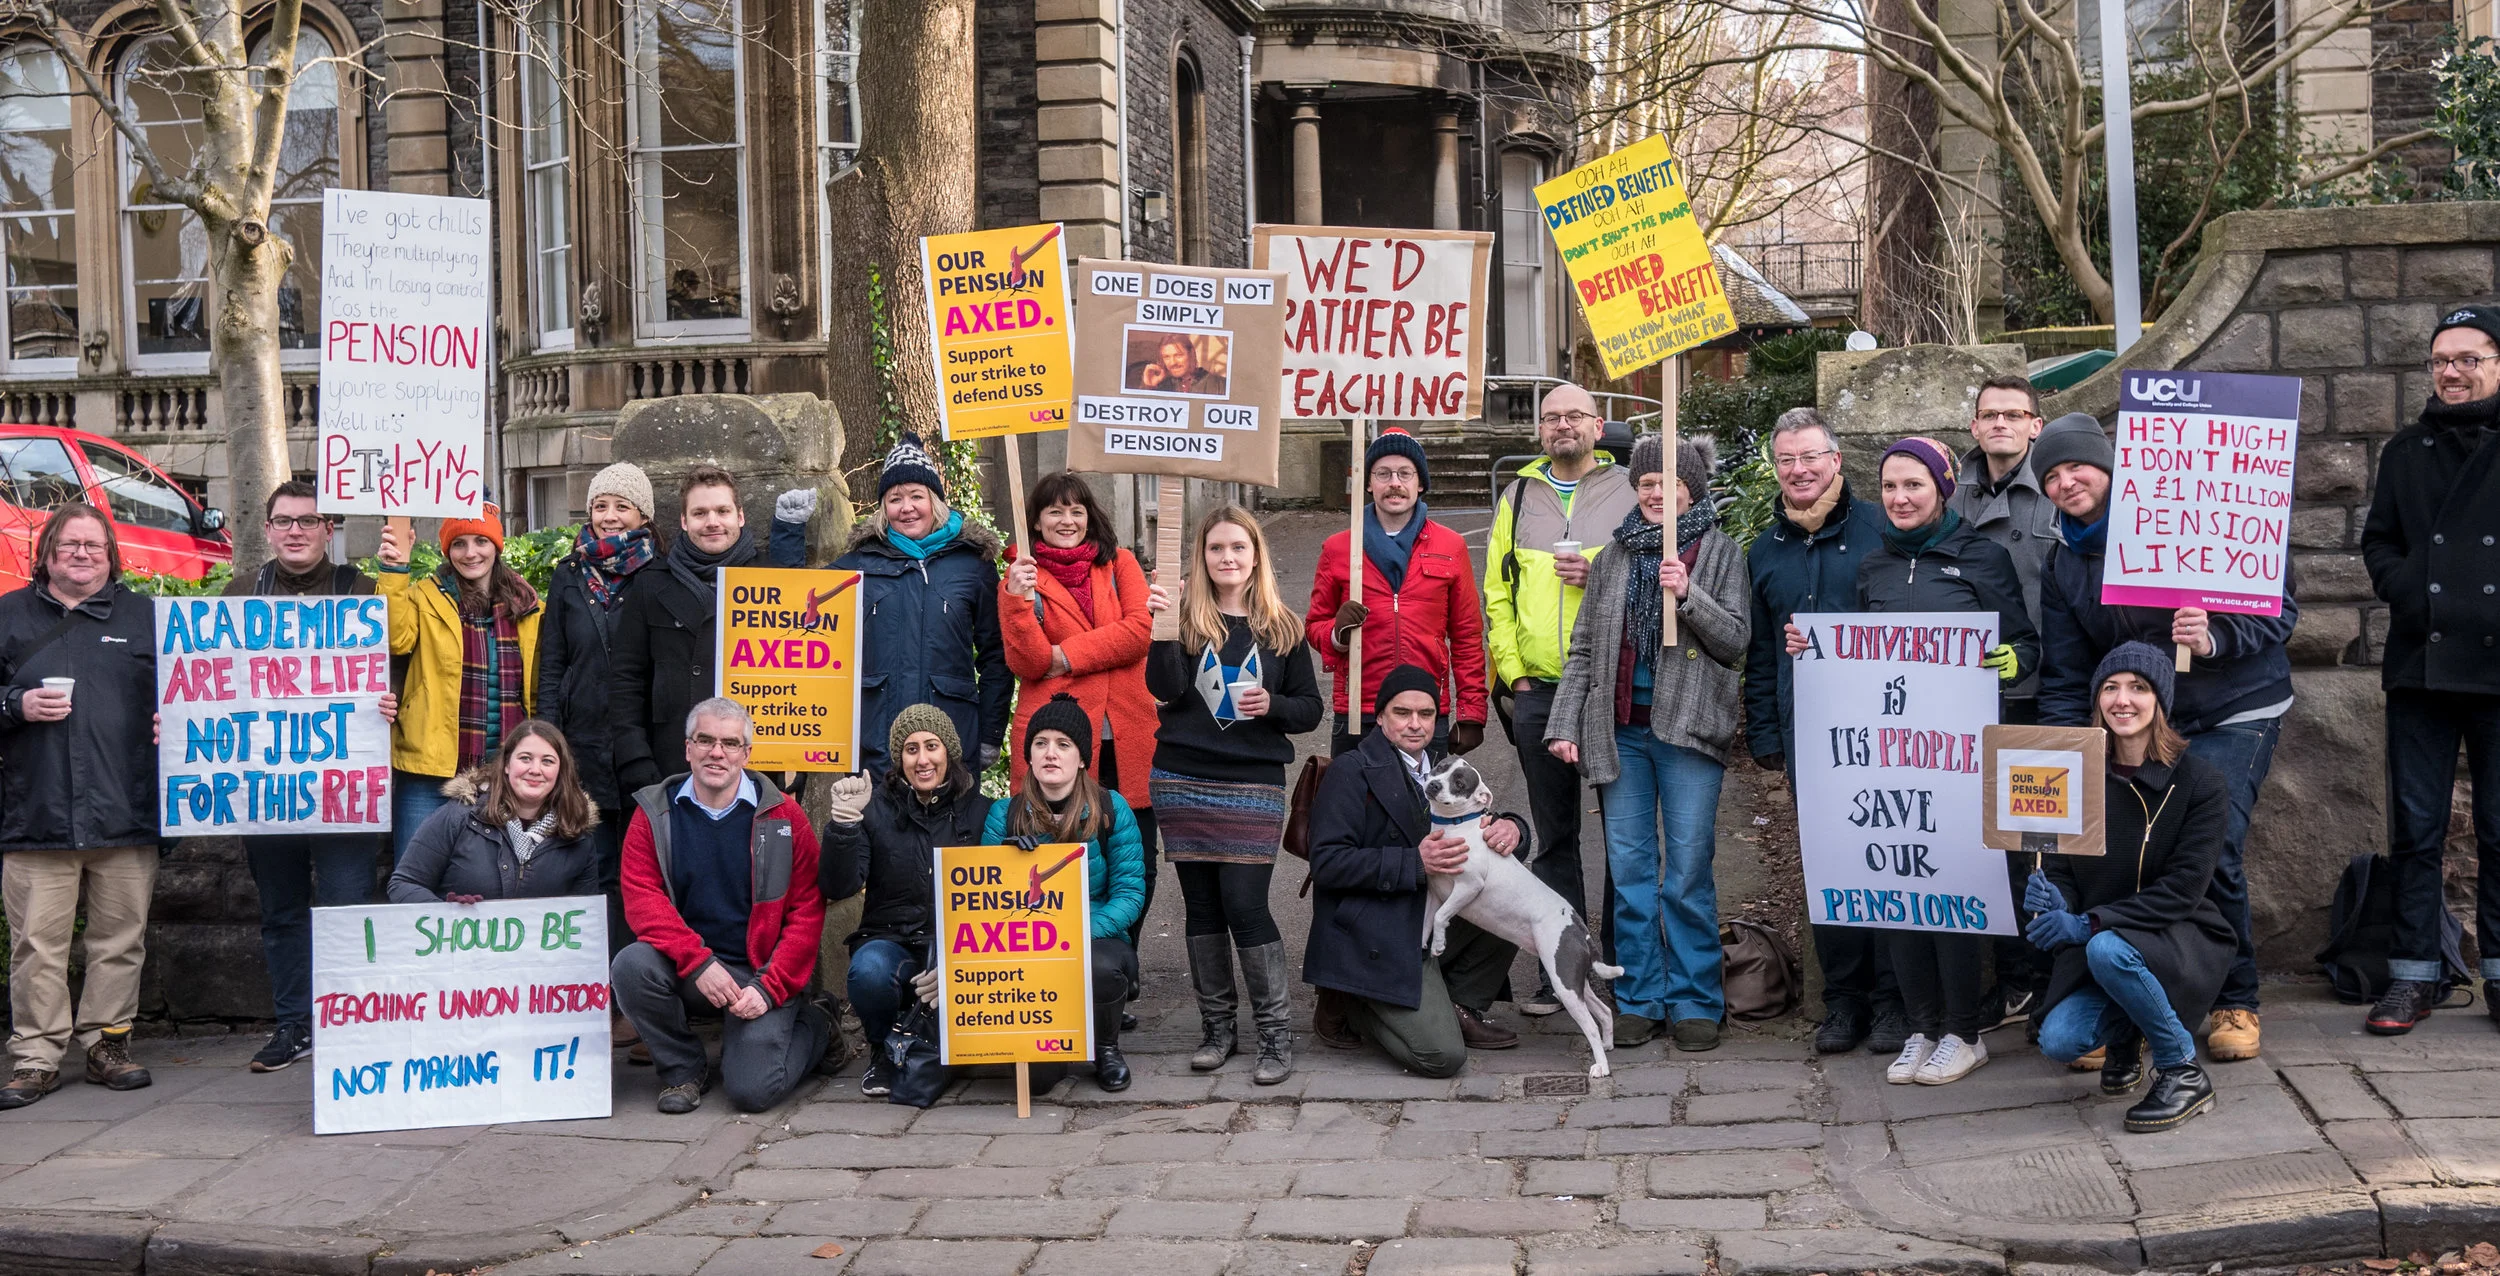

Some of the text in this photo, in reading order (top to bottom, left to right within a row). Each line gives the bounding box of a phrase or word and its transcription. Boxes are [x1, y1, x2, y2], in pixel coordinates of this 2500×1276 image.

[1575, 156, 1629, 189] OOH AH
[1544, 158, 1675, 230] DEFINED BENEFIT
[336, 193, 482, 239] I've got chills
[1593, 199, 1645, 229] OOH AH
[1563, 201, 1691, 262] DON'T SHUT THE DOOR
[1611, 234, 1656, 260] OOH AH
[328, 233, 478, 277] They're multiplying
[937, 250, 986, 272] OUR
[1296, 236, 1425, 294] WE'D
[327, 265, 486, 307] And I'm losing control
[939, 270, 1044, 297] PENSION
[1095, 275, 1271, 300] ONE DOES NOT
[1577, 253, 1665, 307] DEFINED
[1637, 261, 1720, 317] BENEFIT
[328, 295, 399, 319] 'Cos the
[944, 298, 1054, 337] AXED.
[1142, 304, 1220, 325] SIMPLY
[1424, 302, 1468, 358] BE
[1600, 301, 1706, 354] YOU KNOW WHAT
[1648, 323, 1700, 356] LOOKING
[1702, 313, 1730, 336] FOR
[328, 320, 479, 370] PENSION
[948, 345, 1014, 365] Support
[950, 362, 1046, 384] our strike to
[328, 379, 387, 411] you're
[952, 382, 1044, 405] defend USS
[1282, 368, 1467, 417] EACHING
[324, 410, 403, 433] Well it's
[1084, 403, 1253, 426] DESTROY OUR
[1111, 433, 1217, 454] PENSIONS
[2129, 417, 2287, 452] HEY HUGH
[325, 434, 479, 509] PETRIFYING
[2121, 447, 2292, 478] I DON'T HAVE
[2121, 475, 2290, 508] A £1 MILLION
[2136, 506, 2283, 546] PENSION
[2119, 542, 2279, 581] LIKE YOU
[732, 585, 781, 605] OUR
[2201, 595, 2272, 609] www.ucu.org.uk
[163, 598, 385, 655] ACADEMICS
[731, 609, 839, 632] PENSION
[730, 638, 842, 670] AXED.
[1796, 624, 1992, 668] A UNIVERSITY
[162, 653, 387, 704] ARE FOR LIFE
[730, 681, 797, 698] Support
[761, 702, 807, 717] strike
[811, 704, 828, 717] to
[185, 703, 355, 765] NOT JUST
[753, 721, 822, 737] end USS
[1829, 726, 1979, 774] ITS PEOPLE
[2012, 774, 2034, 783] OUR
[165, 766, 389, 826] FOR THIS REF
[1847, 788, 1937, 833] SAVE
[2012, 798, 2063, 814] AXED.
[951, 866, 1002, 886] OUR
[1865, 842, 1939, 878] OUR
[951, 890, 1064, 911] PENSION
[1820, 888, 1988, 930] PENSIONS
[364, 909, 586, 963] I SHOULD BE
[952, 920, 1071, 954] AXED.
[954, 967, 1024, 986] Support
[314, 982, 610, 1029] TEACHING UNION HISTORY
[954, 988, 1058, 1005] our strike to
[955, 1010, 1053, 1026] defend USS
[332, 1036, 580, 1101] NOT MAKING IT!
